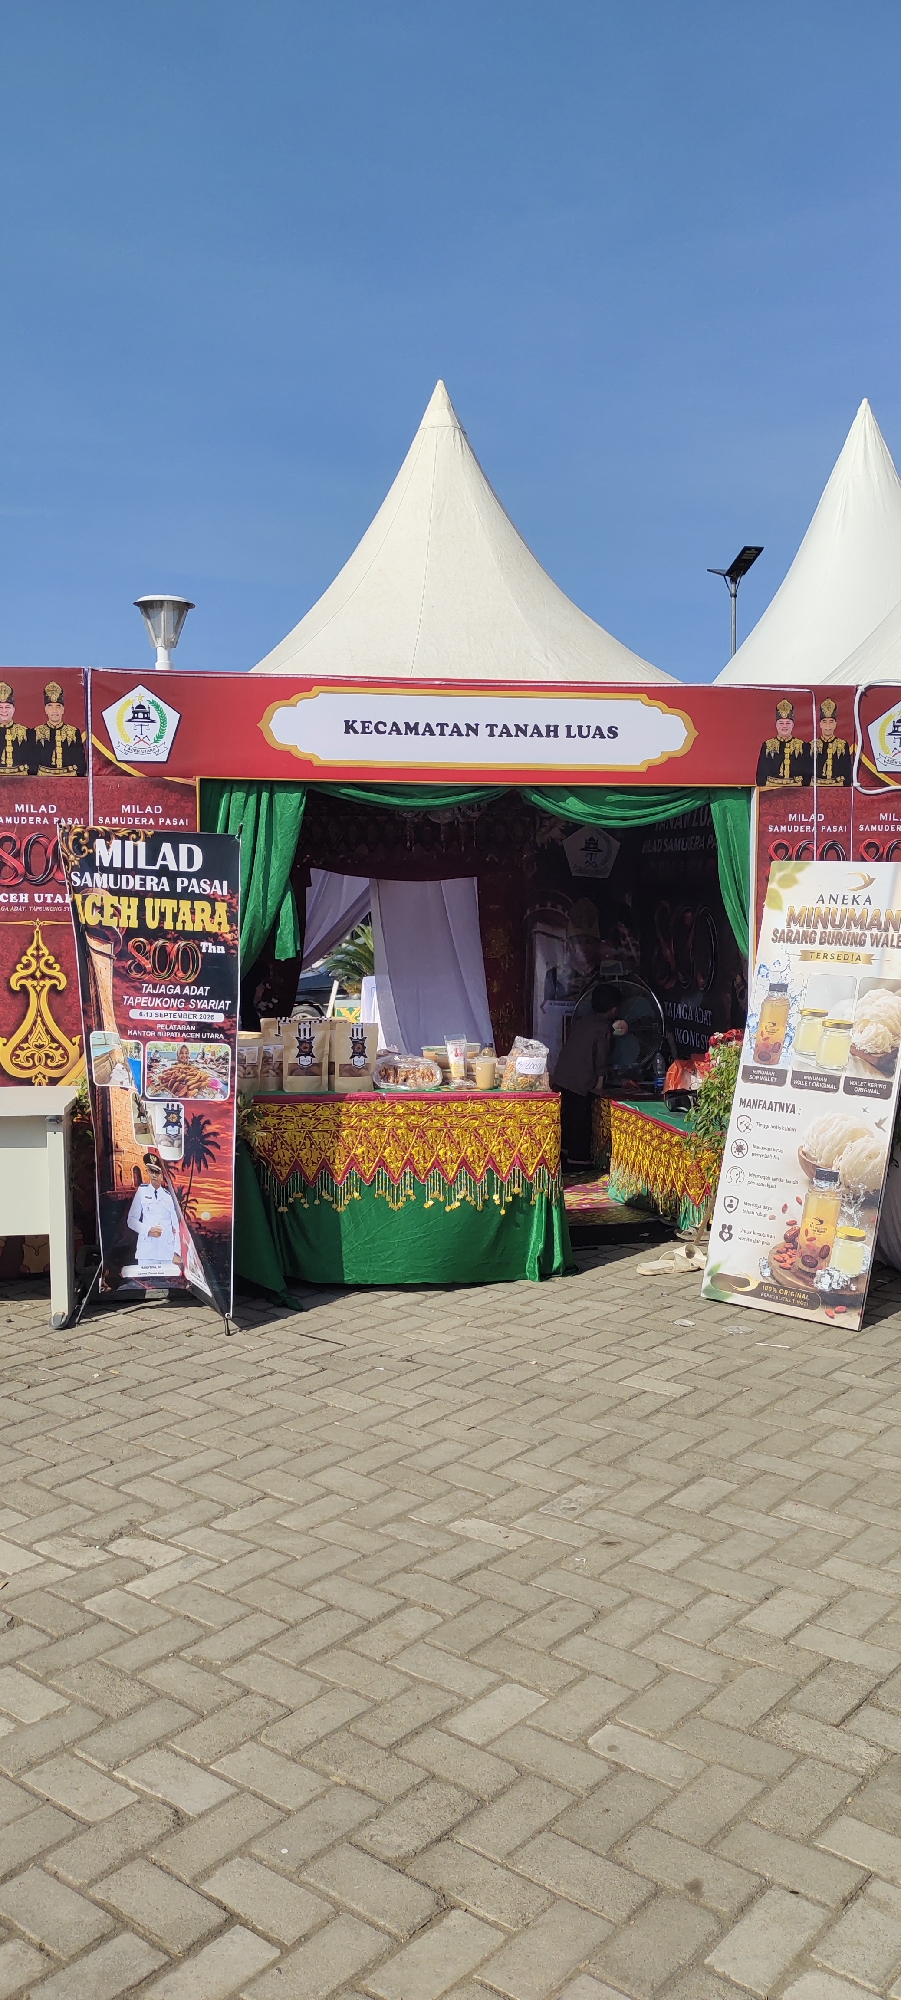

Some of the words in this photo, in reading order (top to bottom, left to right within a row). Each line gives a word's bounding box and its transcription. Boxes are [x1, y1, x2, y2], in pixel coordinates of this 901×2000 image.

[343, 719, 480, 737] KECAMATAN
[485, 723, 560, 739] TANAH
[565, 724, 619, 740] LUAS
[15, 804, 57, 814] MILAD
[121, 804, 163, 814] MILAD
[0, 816, 50, 825] AMUDERA
[54, 817, 84, 825] PASAI
[98, 816, 155, 826] SAMUDERA
[159, 818, 189, 826] PASAI
[788, 813, 825, 822] MILAD
[880, 812, 901, 822] MIL
[768, 824, 818, 833] SAMUDERA
[821, 825, 847, 833] PASAI
[858, 824, 901, 832] SAMUDER
[95, 838, 204, 872] MILAD
[71, 872, 170, 892] SAMUDERA
[176, 877, 228, 896] PASAI
[0, 893, 30, 903] CEH
[34, 893, 70, 904] UTA
[816, 894, 872, 906] ANEKA
[74, 894, 139, 929] ACEH
[144, 897, 230, 933] UTARA
[786, 905, 901, 934] MINUMAN
[771, 928, 818, 944] SARANG
[819, 930, 868, 948] BURUNG
[870, 932, 901, 949] WALE
[126, 937, 202, 984] 800
[200, 941, 226, 954] Thn
[810, 952, 862, 962] TERSEDIA
[142, 984, 180, 995] TAJAGA
[182, 986, 210, 996] ADAT
[122, 995, 186, 1008] TAPEUKONG
[189, 999, 232, 1010] SYARIAT
[154, 1012, 198, 1020] SEPTEMBER
[738, 1097, 796, 1115] MANFAATNYA
[778, 1288, 810, 1300] ORIGINAL
